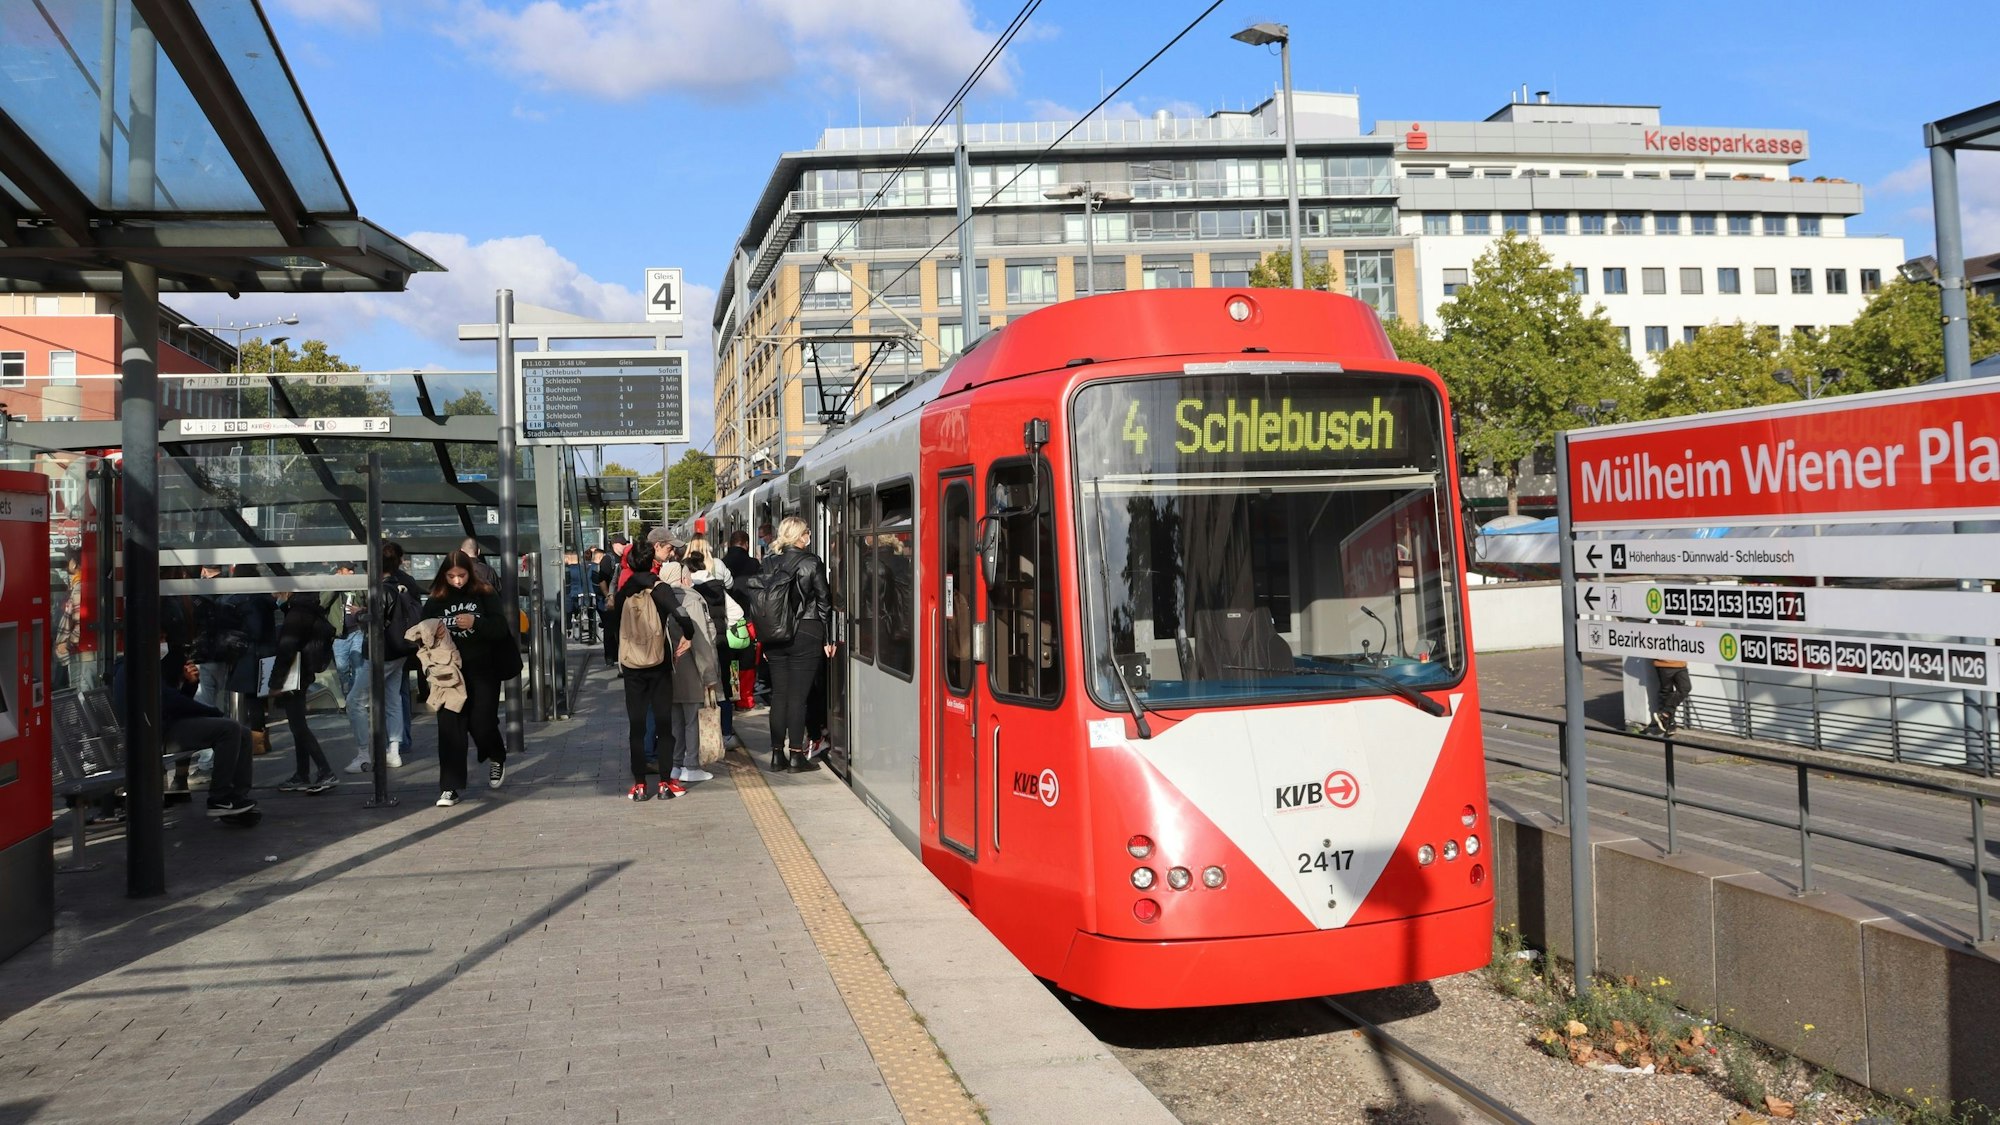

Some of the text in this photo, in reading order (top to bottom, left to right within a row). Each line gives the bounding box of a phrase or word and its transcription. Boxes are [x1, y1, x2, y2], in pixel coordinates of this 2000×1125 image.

[1645, 130, 1802, 155] Kreissparkasse
[653, 272, 674, 280] Gleis
[652, 283, 676, 310] 4
[225, 422, 235, 431] 13
[238, 422, 248, 431] 18
[645, 428, 678, 436] bewerben
[1123, 397, 1393, 454] 4 Schlebusch
[1581, 421, 2000, 503] Mülheim Wiener Pla
[490, 514, 495, 522] 3
[632, 510, 638, 518] 4
[1613, 548, 1794, 565] 4 Höhenhaus Dünnwald Schlebusch
[444, 602, 477, 616] ADAMS
[1665, 593, 1687, 610] 151
[1691, 594, 1714, 611] 152
[1719, 595, 1743, 613] 153
[1748, 596, 1772, 614] 159
[1777, 597, 1804, 616] 171
[1608, 629, 1705, 654] Bezirksrathaus
[1741, 640, 1766, 659] 150
[1772, 642, 1798, 662] 155
[1804, 645, 1831, 665] 156
[1836, 647, 1866, 668] 250
[1872, 650, 1904, 671] 260
[1909, 653, 1943, 675] 434
[1952, 656, 1985, 679] N26
[1014, 771, 1039, 795] KVB
[1276, 782, 1322, 809] KVB
[1298, 849, 1354, 873] 2417
[1329, 884, 1333, 894] 1
